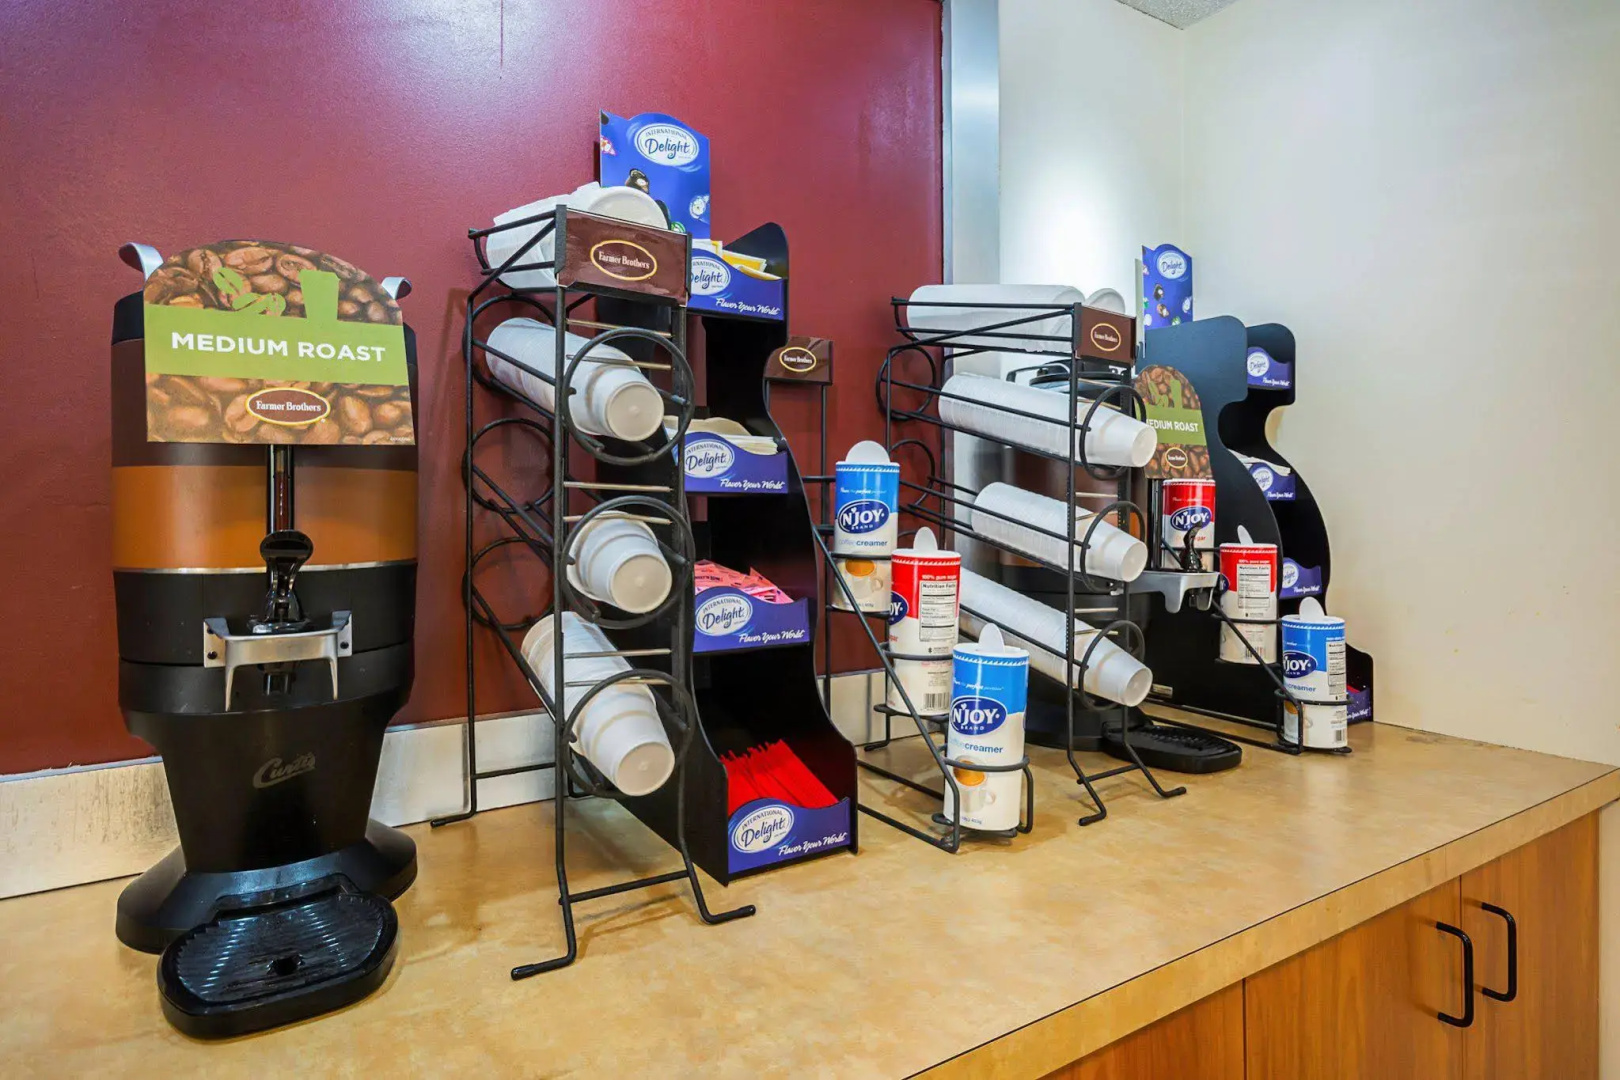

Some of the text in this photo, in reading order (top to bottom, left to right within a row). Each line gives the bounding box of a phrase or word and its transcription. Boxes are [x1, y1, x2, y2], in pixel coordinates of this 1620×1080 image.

[646, 129, 688, 140] INTERNATIONAL
[645, 138, 690, 160] Delight
[598, 251, 650, 269] Farmer Brothers
[715, 298, 781, 315] Flavor Your World
[171, 332, 386, 362] MEDIUM ROAST
[256, 400, 321, 411] Farmer Brothers
[1174, 422, 1199, 432] ROAST
[686, 443, 724, 454] INTERNATIONAL
[685, 452, 727, 472] Delight
[720, 479, 785, 490] Flavor Your World
[842, 507, 883, 527] N'JOY
[703, 597, 742, 613] INTERNATIONAL
[703, 606, 744, 630] Delight
[739, 630, 805, 643] Flavor Your World
[953, 703, 998, 726] N'JOY
[964, 743, 1003, 753] creamer
[742, 810, 783, 830] INTERNATIONAL
[741, 818, 786, 847] Delight
[778, 833, 848, 856] Flavor Your World
